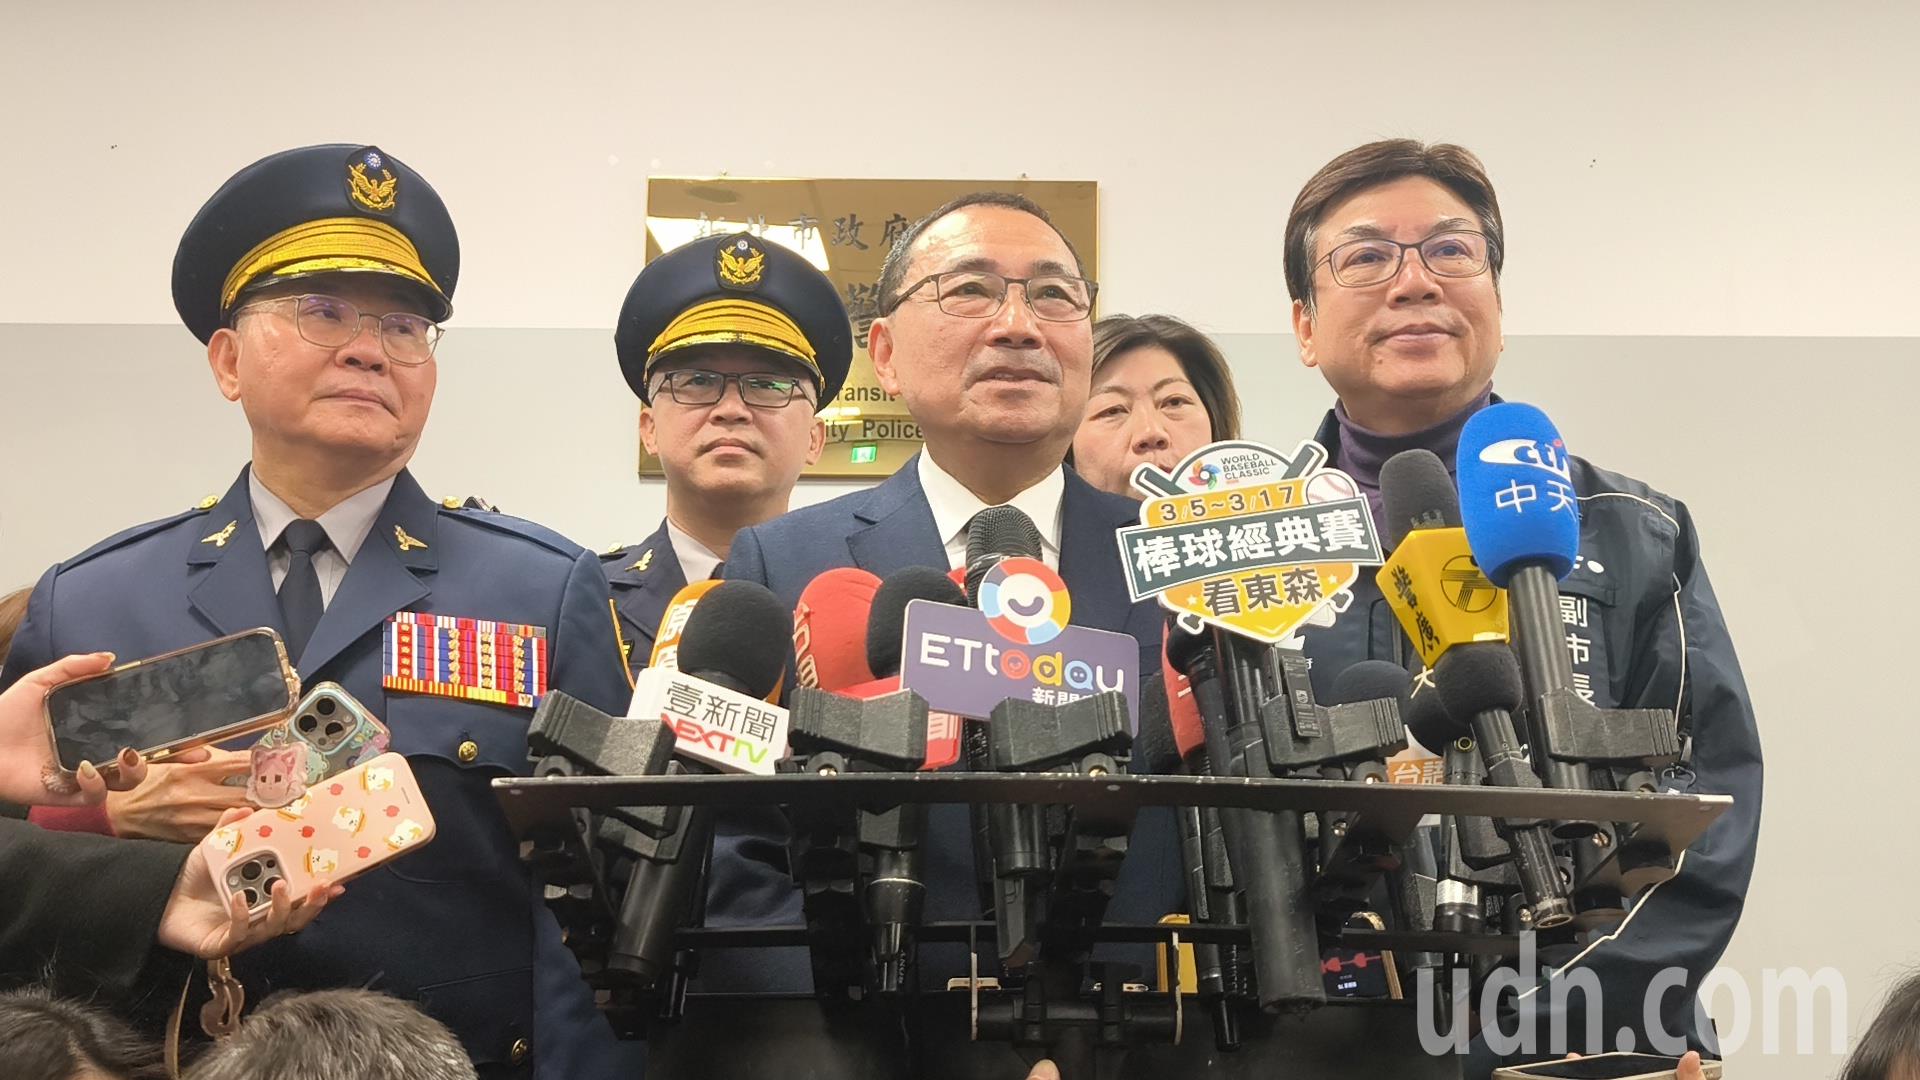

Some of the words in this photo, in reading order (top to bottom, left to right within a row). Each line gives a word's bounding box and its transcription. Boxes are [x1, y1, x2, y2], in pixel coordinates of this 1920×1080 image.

[826, 419, 849, 441] ity
[862, 419, 923, 439] Police
[1221, 453, 1260, 465] WORLD
[1223, 459, 1277, 473] BASEBALL
[1225, 467, 1270, 480] CLASSIC
[1495, 479, 1577, 522] 中天
[1133, 508, 1370, 583] 棒球經典賽
[1203, 567, 1323, 617] 看東森
[919, 632, 1125, 692] ETtoday
[1032, 686, 1098, 706] 新聞
[1410, 665, 1436, 699] 大
[663, 681, 778, 743] 壹新聞
